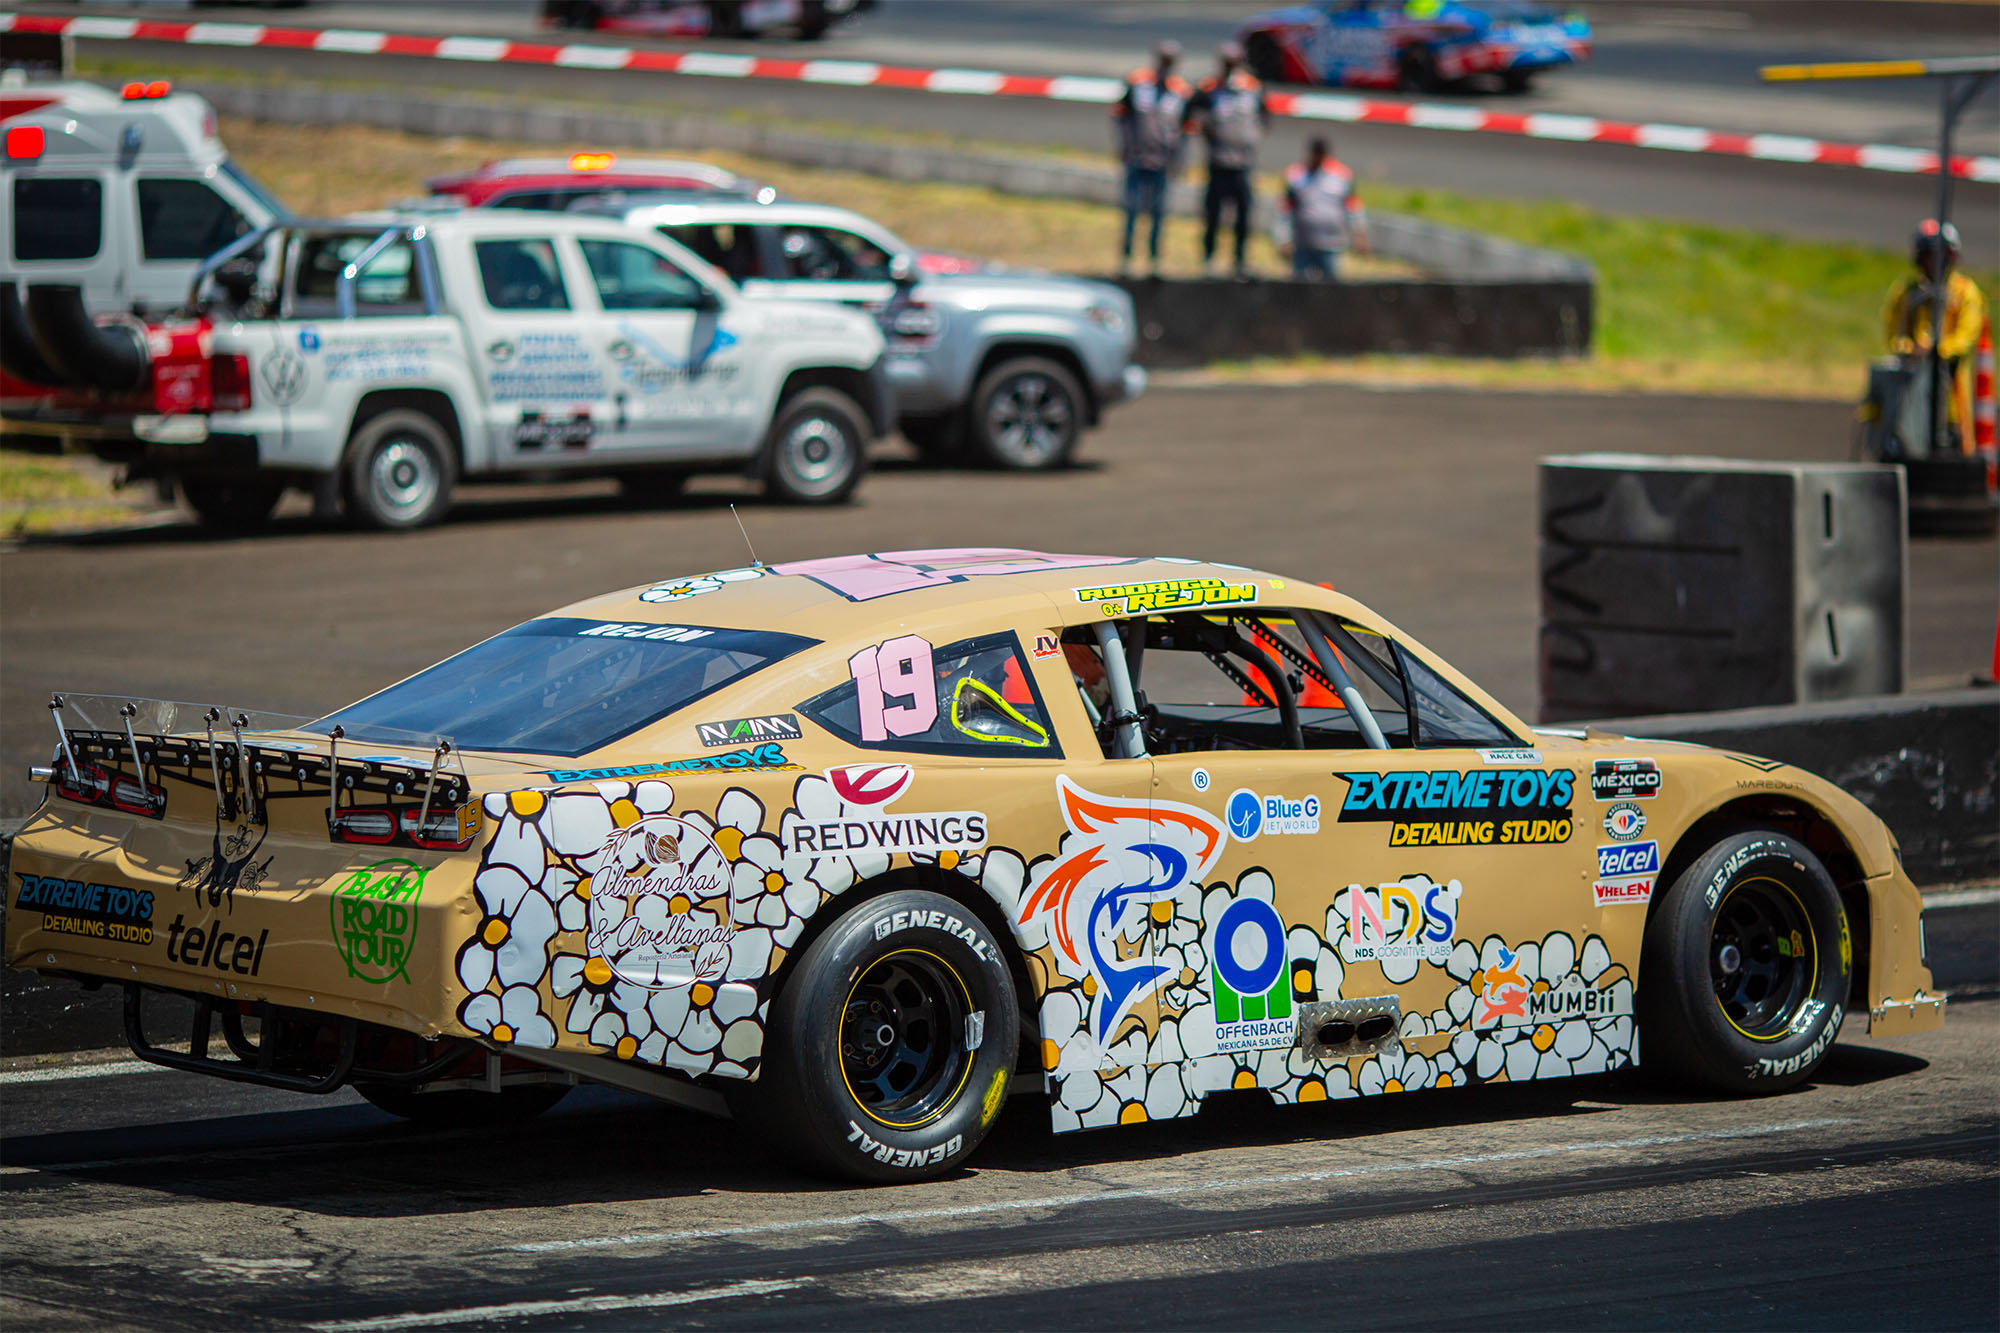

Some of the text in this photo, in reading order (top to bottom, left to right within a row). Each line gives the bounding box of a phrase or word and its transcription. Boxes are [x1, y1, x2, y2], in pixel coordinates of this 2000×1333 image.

[1079, 579, 1222, 601] RODRIGO
[1127, 585, 1256, 612] REJON
[578, 624, 715, 642] REJON
[849, 634, 938, 741] 19
[550, 743, 786, 782] EXTREME TOYS
[1343, 771, 1574, 810] EXTREME TOYS
[1592, 772, 1659, 788] MÉXICO
[457, 799, 482, 843] 19
[1266, 798, 1318, 818] Blue G
[793, 816, 986, 853] REDWINGS
[1266, 820, 1318, 831] JET WORLD
[1391, 819, 1572, 846] DETAILING STUDIO
[1599, 845, 1655, 874] telcel
[18, 875, 153, 919] EXTREME TOYS
[341, 870, 418, 903] BASH
[590, 865, 721, 897] Almendras
[44, 915, 153, 943] DETAILING STUDIO
[339, 896, 409, 936] ROAD
[589, 913, 736, 949] & Avellanas
[1350, 886, 1453, 945] NDS
[168, 914, 269, 977] telcel
[874, 909, 988, 963] GENERAL
[1354, 945, 1452, 958] NDS COGNITIVE LABS
[343, 931, 411, 984] TOUR
[1215, 1020, 1293, 1040] OFFENBACH
[1217, 1036, 1294, 1051] MEXICANA SA DE CV
[1759, 1003, 1843, 1077] GENERAL
[847, 1119, 963, 1168] GENERAL
